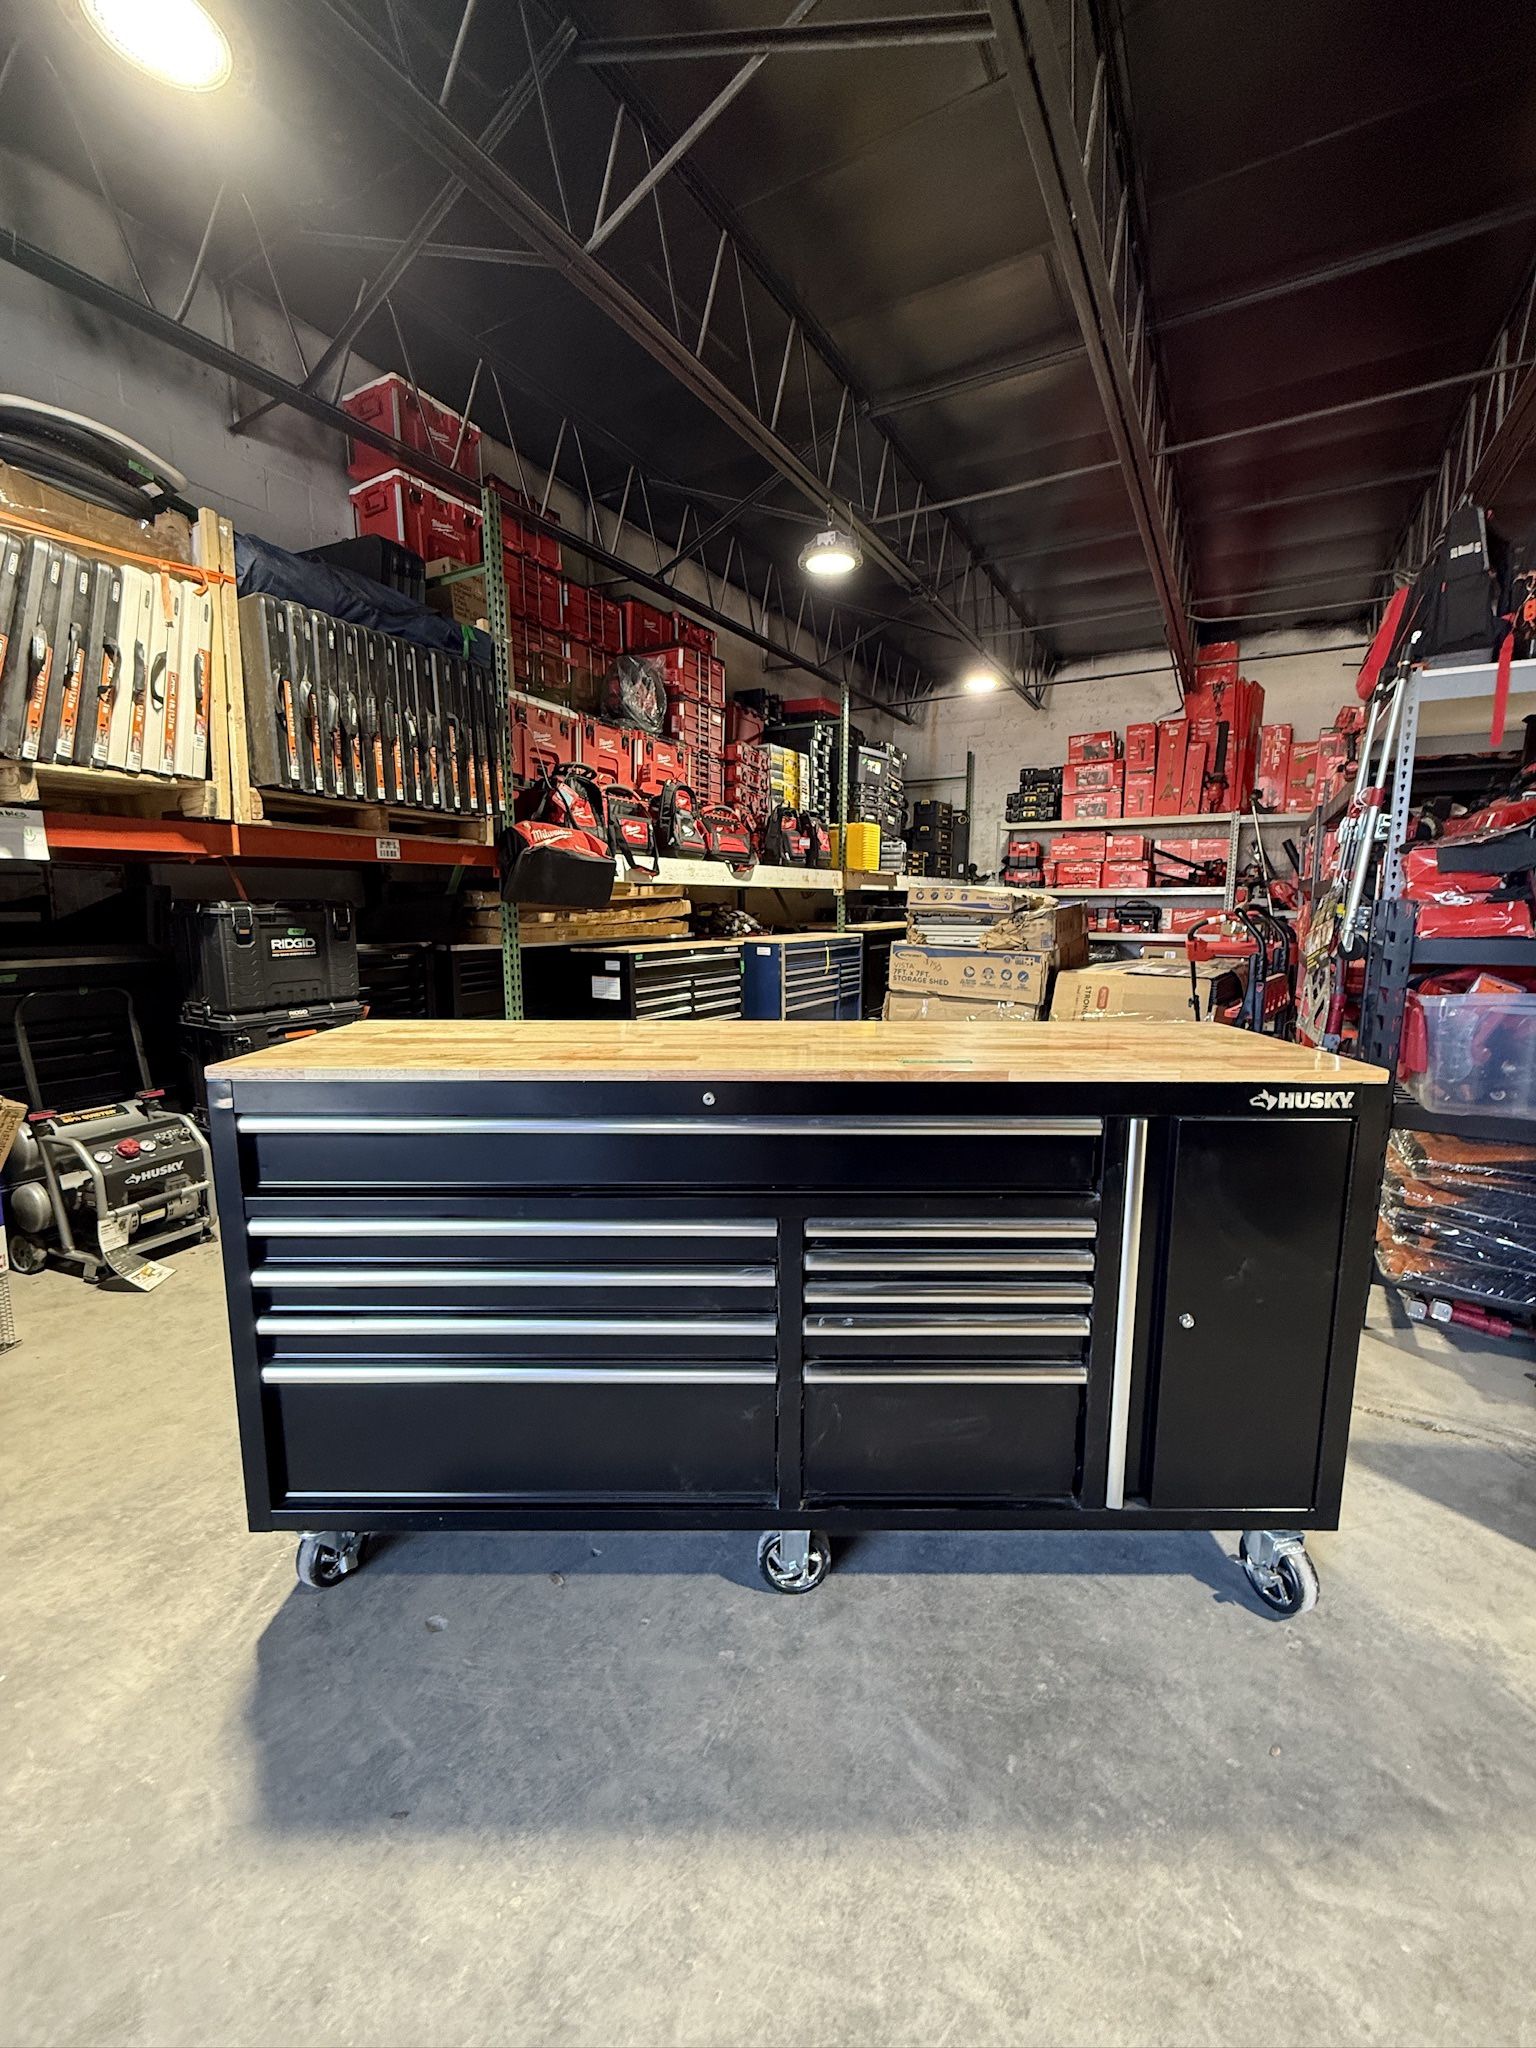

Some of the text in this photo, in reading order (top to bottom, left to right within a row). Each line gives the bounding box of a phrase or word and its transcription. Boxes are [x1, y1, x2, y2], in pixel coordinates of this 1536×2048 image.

[270, 937, 316, 949] RIDGID
[893, 975, 927, 984] STORAGE
[1278, 1091, 1356, 1109] HUSKY
[141, 1160, 185, 1182] HUSKY
